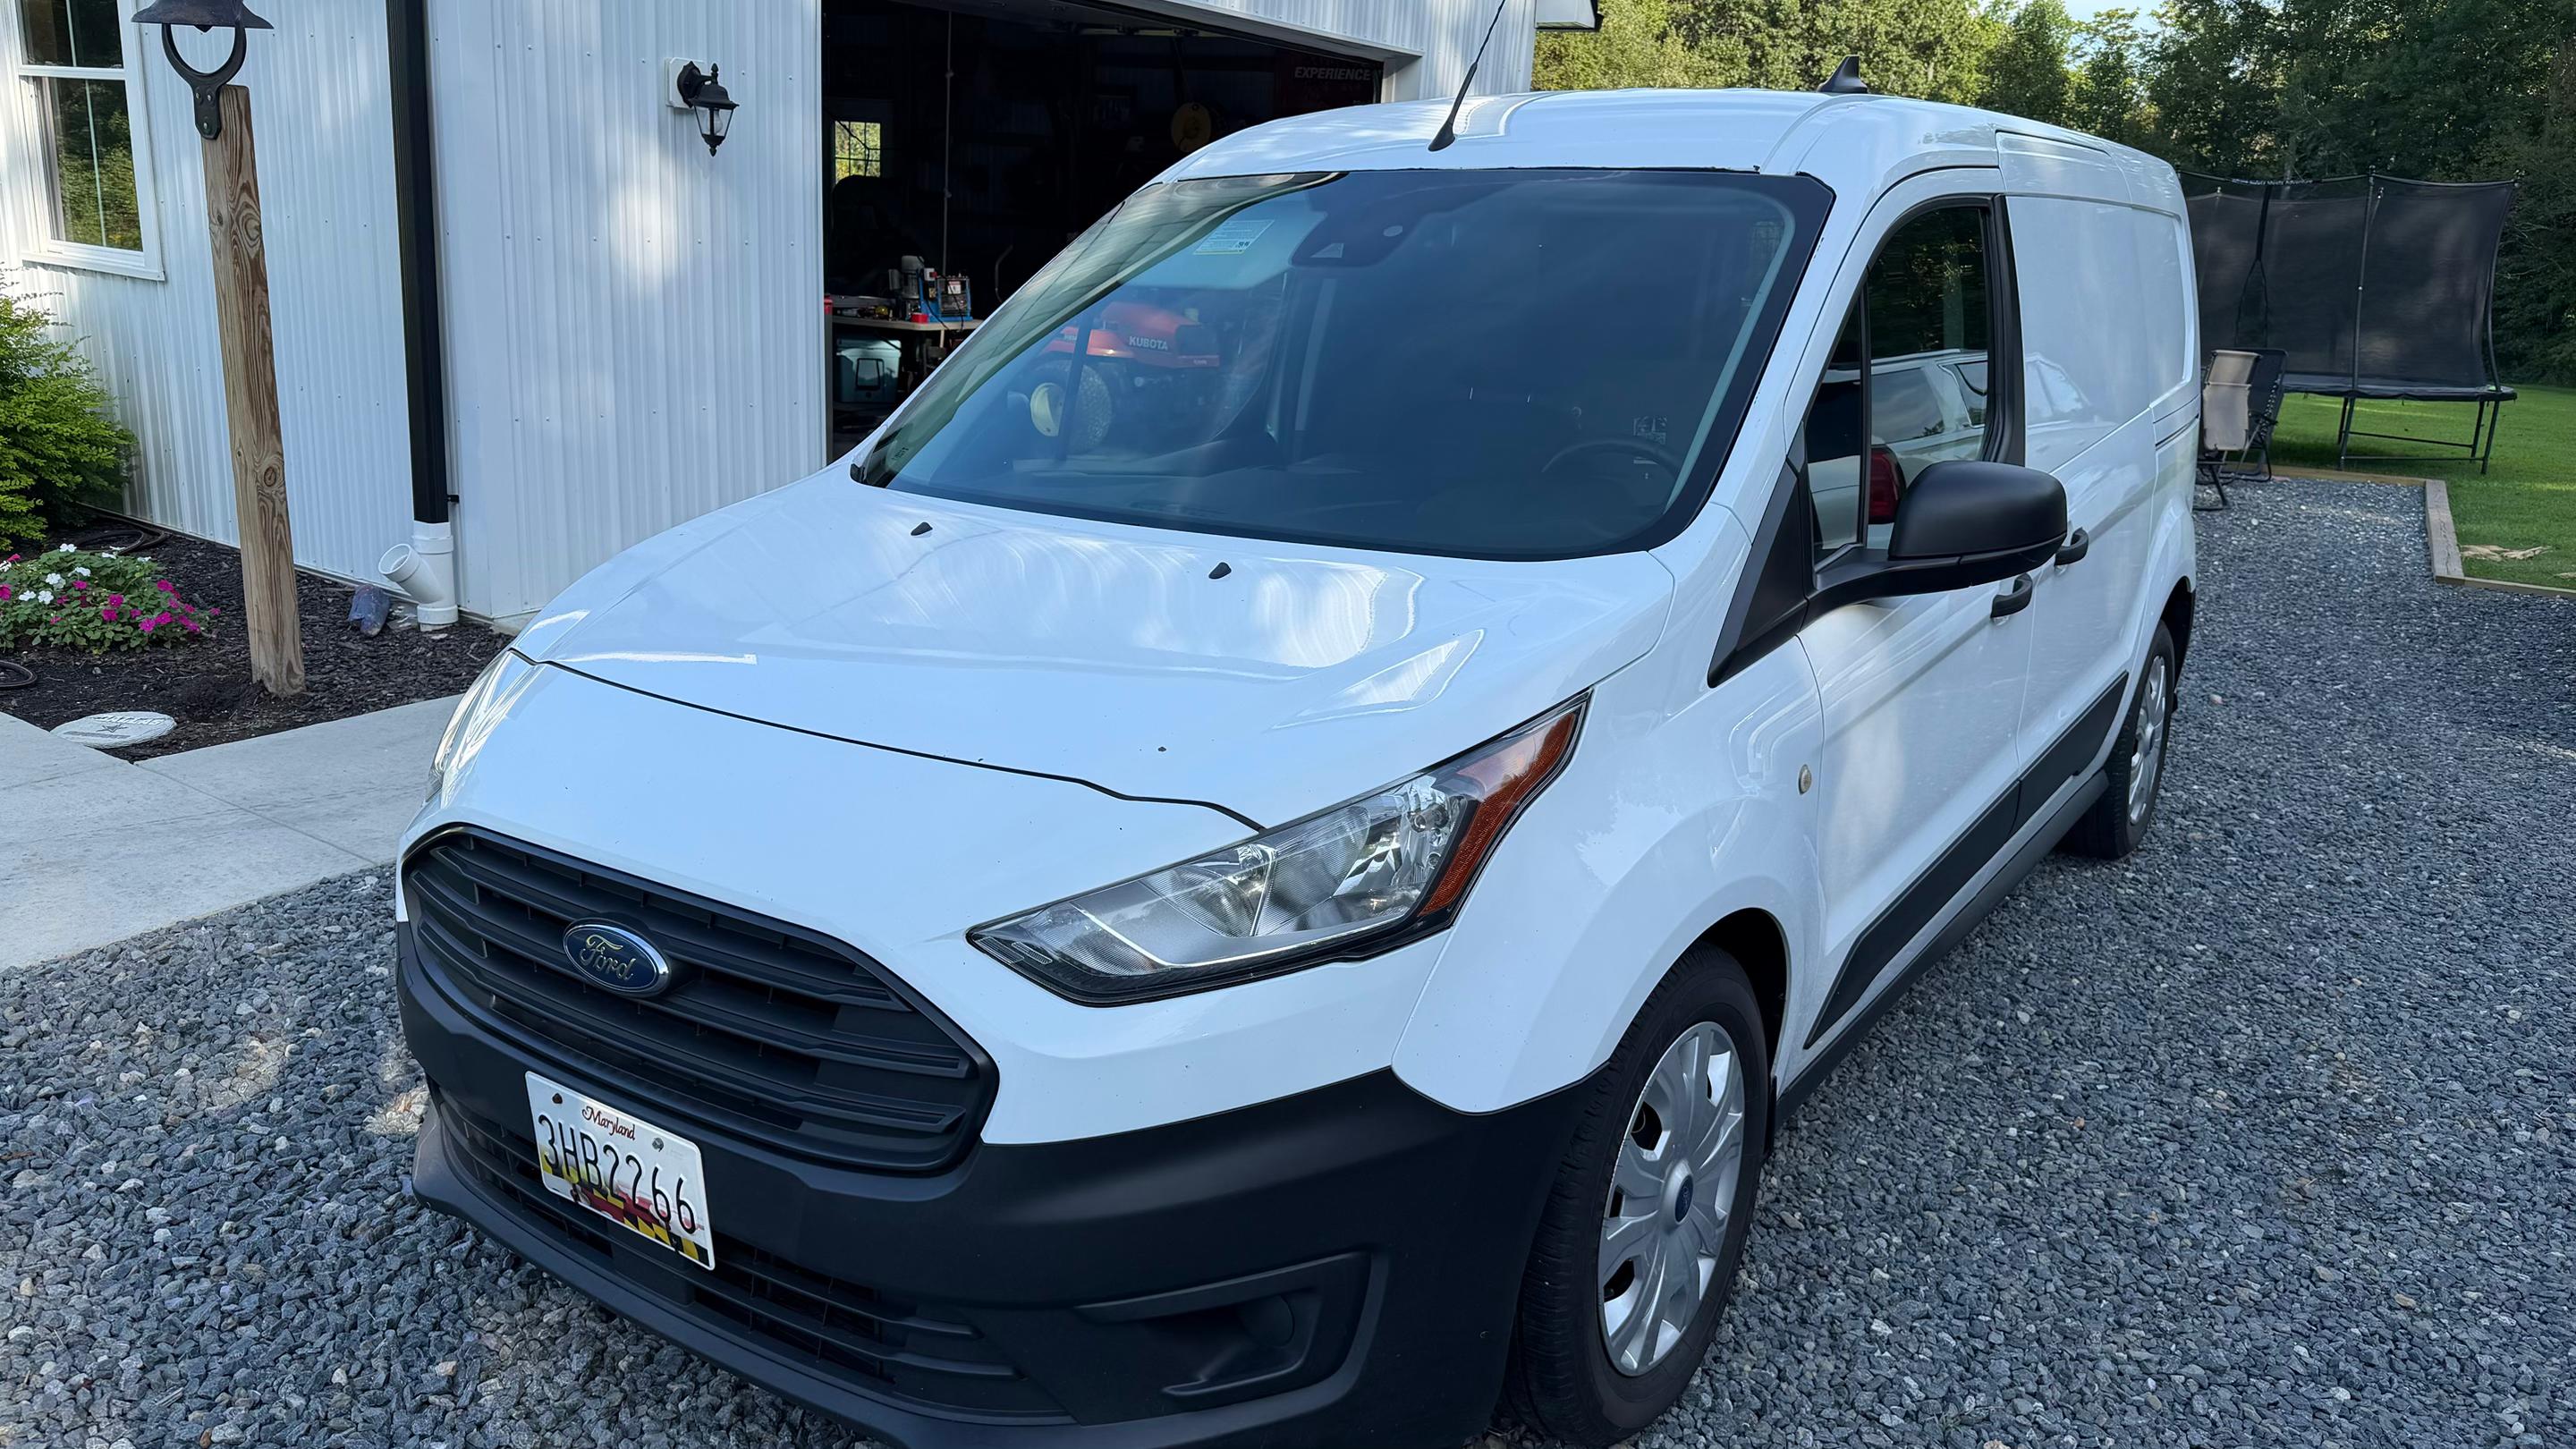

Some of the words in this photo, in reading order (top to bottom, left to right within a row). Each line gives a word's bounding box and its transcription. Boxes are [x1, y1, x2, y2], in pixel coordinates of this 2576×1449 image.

[1294, 66, 1371, 80] EXPERIENCE
[1129, 335, 1168, 351] KUBOTA
[580, 934, 637, 980] Ford
[581, 1106, 636, 1141] Maryland
[538, 1114, 696, 1235] 3HB2266
